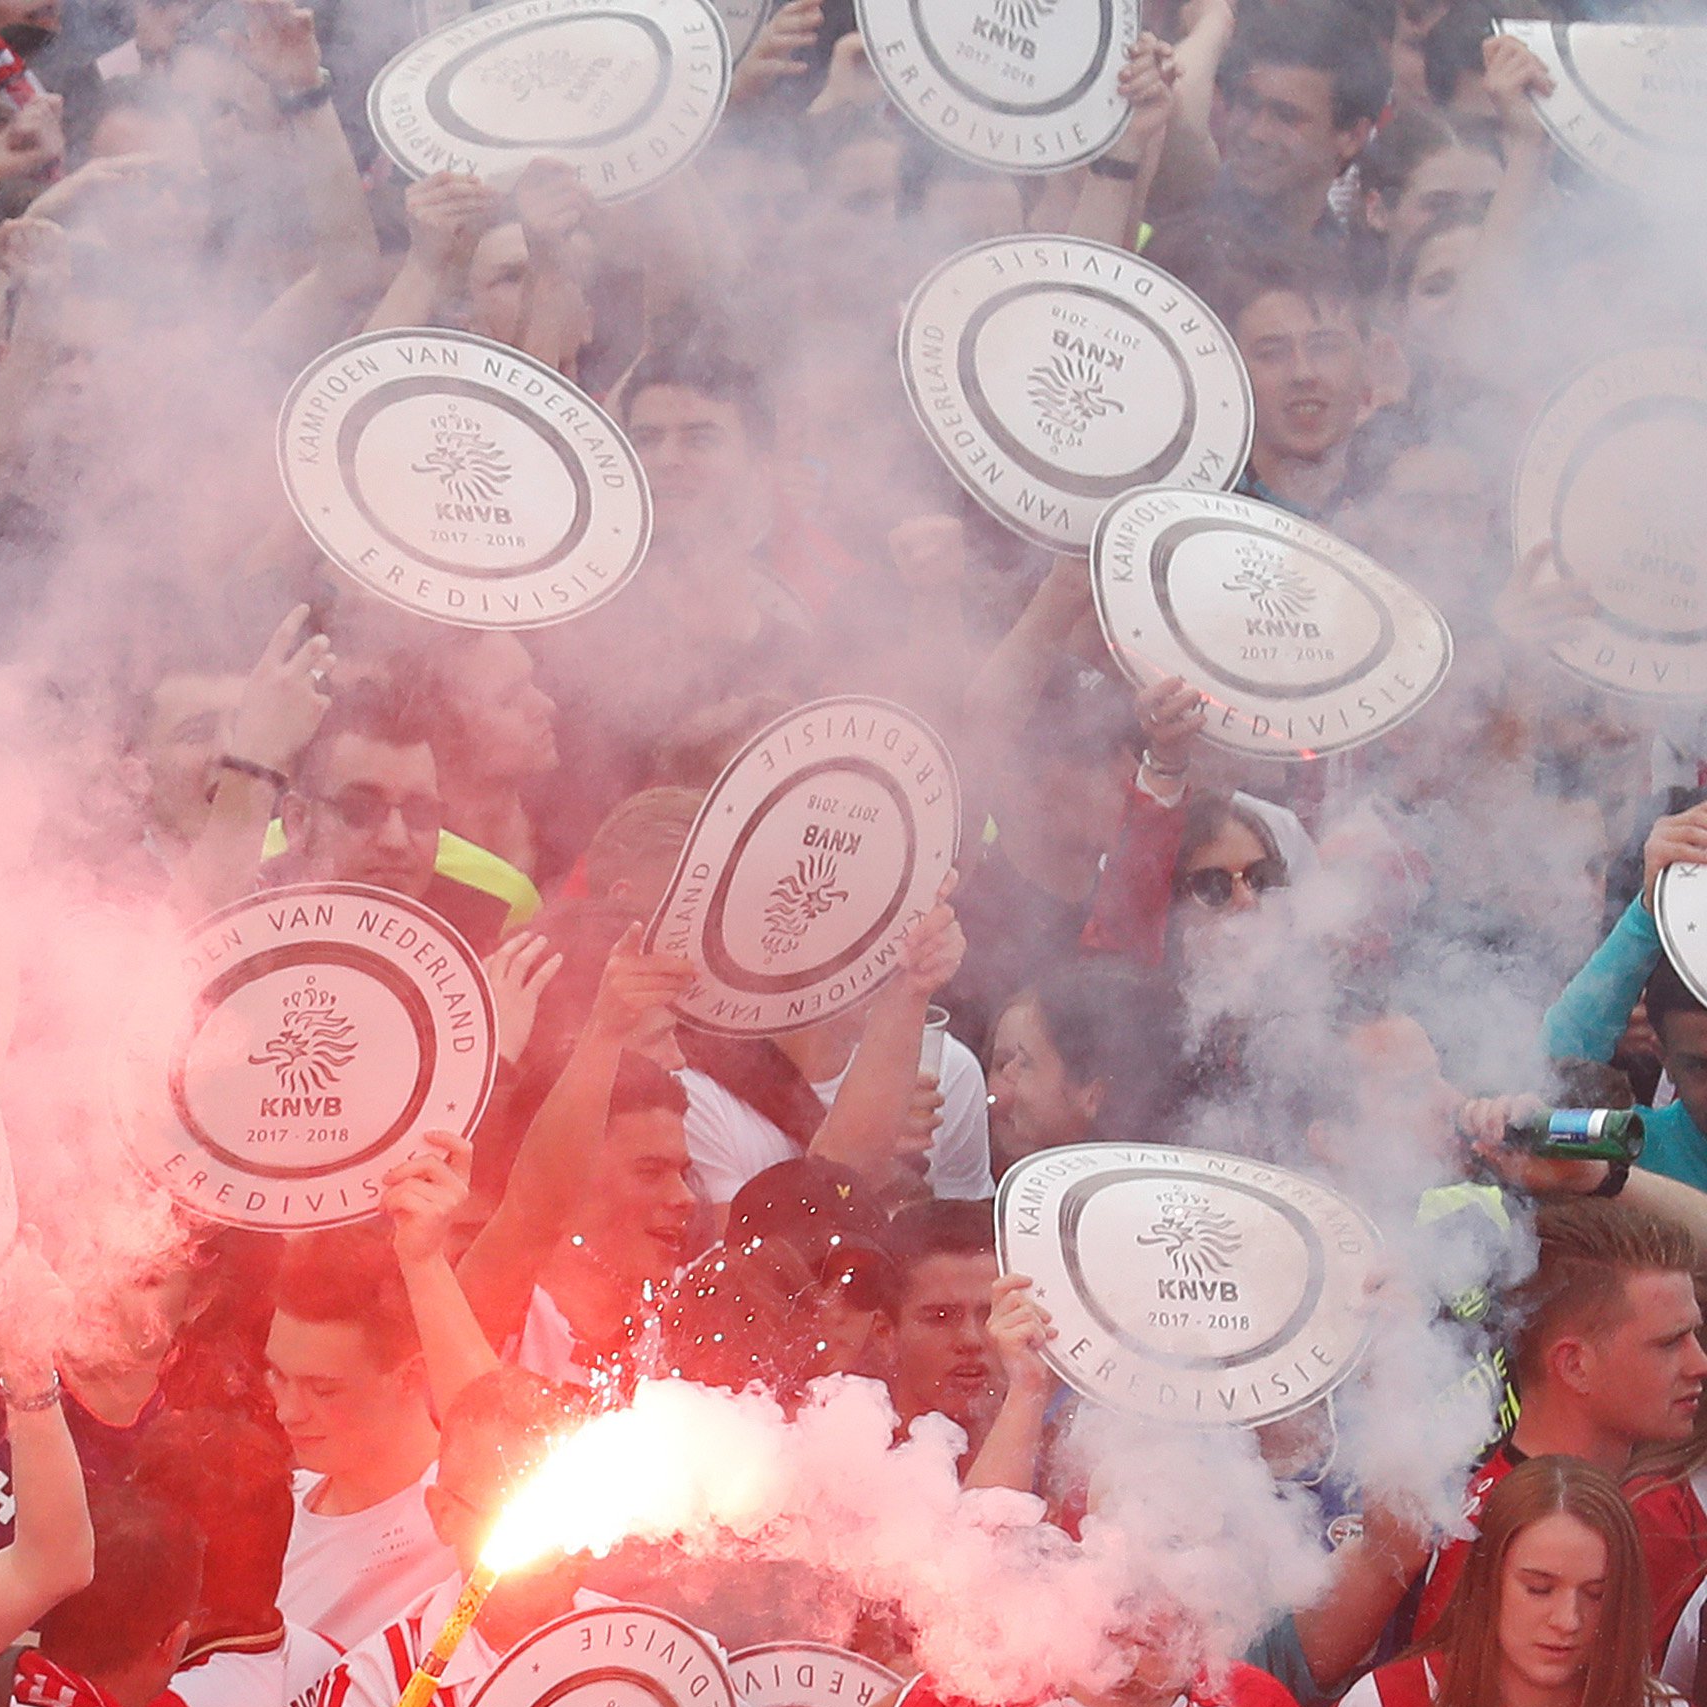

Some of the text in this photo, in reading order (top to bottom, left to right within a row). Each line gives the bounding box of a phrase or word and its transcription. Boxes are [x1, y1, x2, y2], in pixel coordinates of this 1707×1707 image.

[972, 15, 1036, 59] KNVB
[885, 39, 1088, 156] EREDIVISIE
[988, 248, 1218, 357] EREDIVISIE
[1053, 329, 1124, 372] KNVB
[299, 346, 625, 489] KAMPIOEN VAN NEDERLAND
[924, 325, 1070, 530] VAN NEDERLAND
[436, 502, 513, 525] KNVB
[430, 530, 526, 548] 2017 2018
[1112, 498, 1181, 583] KAMPIOEN
[360, 548, 608, 612] EREDIVISIE
[1245, 619, 1321, 639] KNVB
[1240, 646, 1335, 662] 2017 2018
[1191, 673, 1416, 739] REDIVISIE
[760, 715, 943, 807] EREDIVISIE
[803, 825, 862, 855] KNVB
[268, 903, 476, 1057] VAN NEDERLAND
[709, 999, 760, 1023] VAN
[259, 1096, 343, 1118] KNVB
[245, 1127, 349, 1144] 2017 2018
[1017, 1150, 1181, 1237] KAMPIOEN VAN
[1157, 1278, 1240, 1303] KNVB
[1147, 1310, 1251, 1332] 2017 2018
[1067, 1336, 1335, 1411] EREDIVISIE
